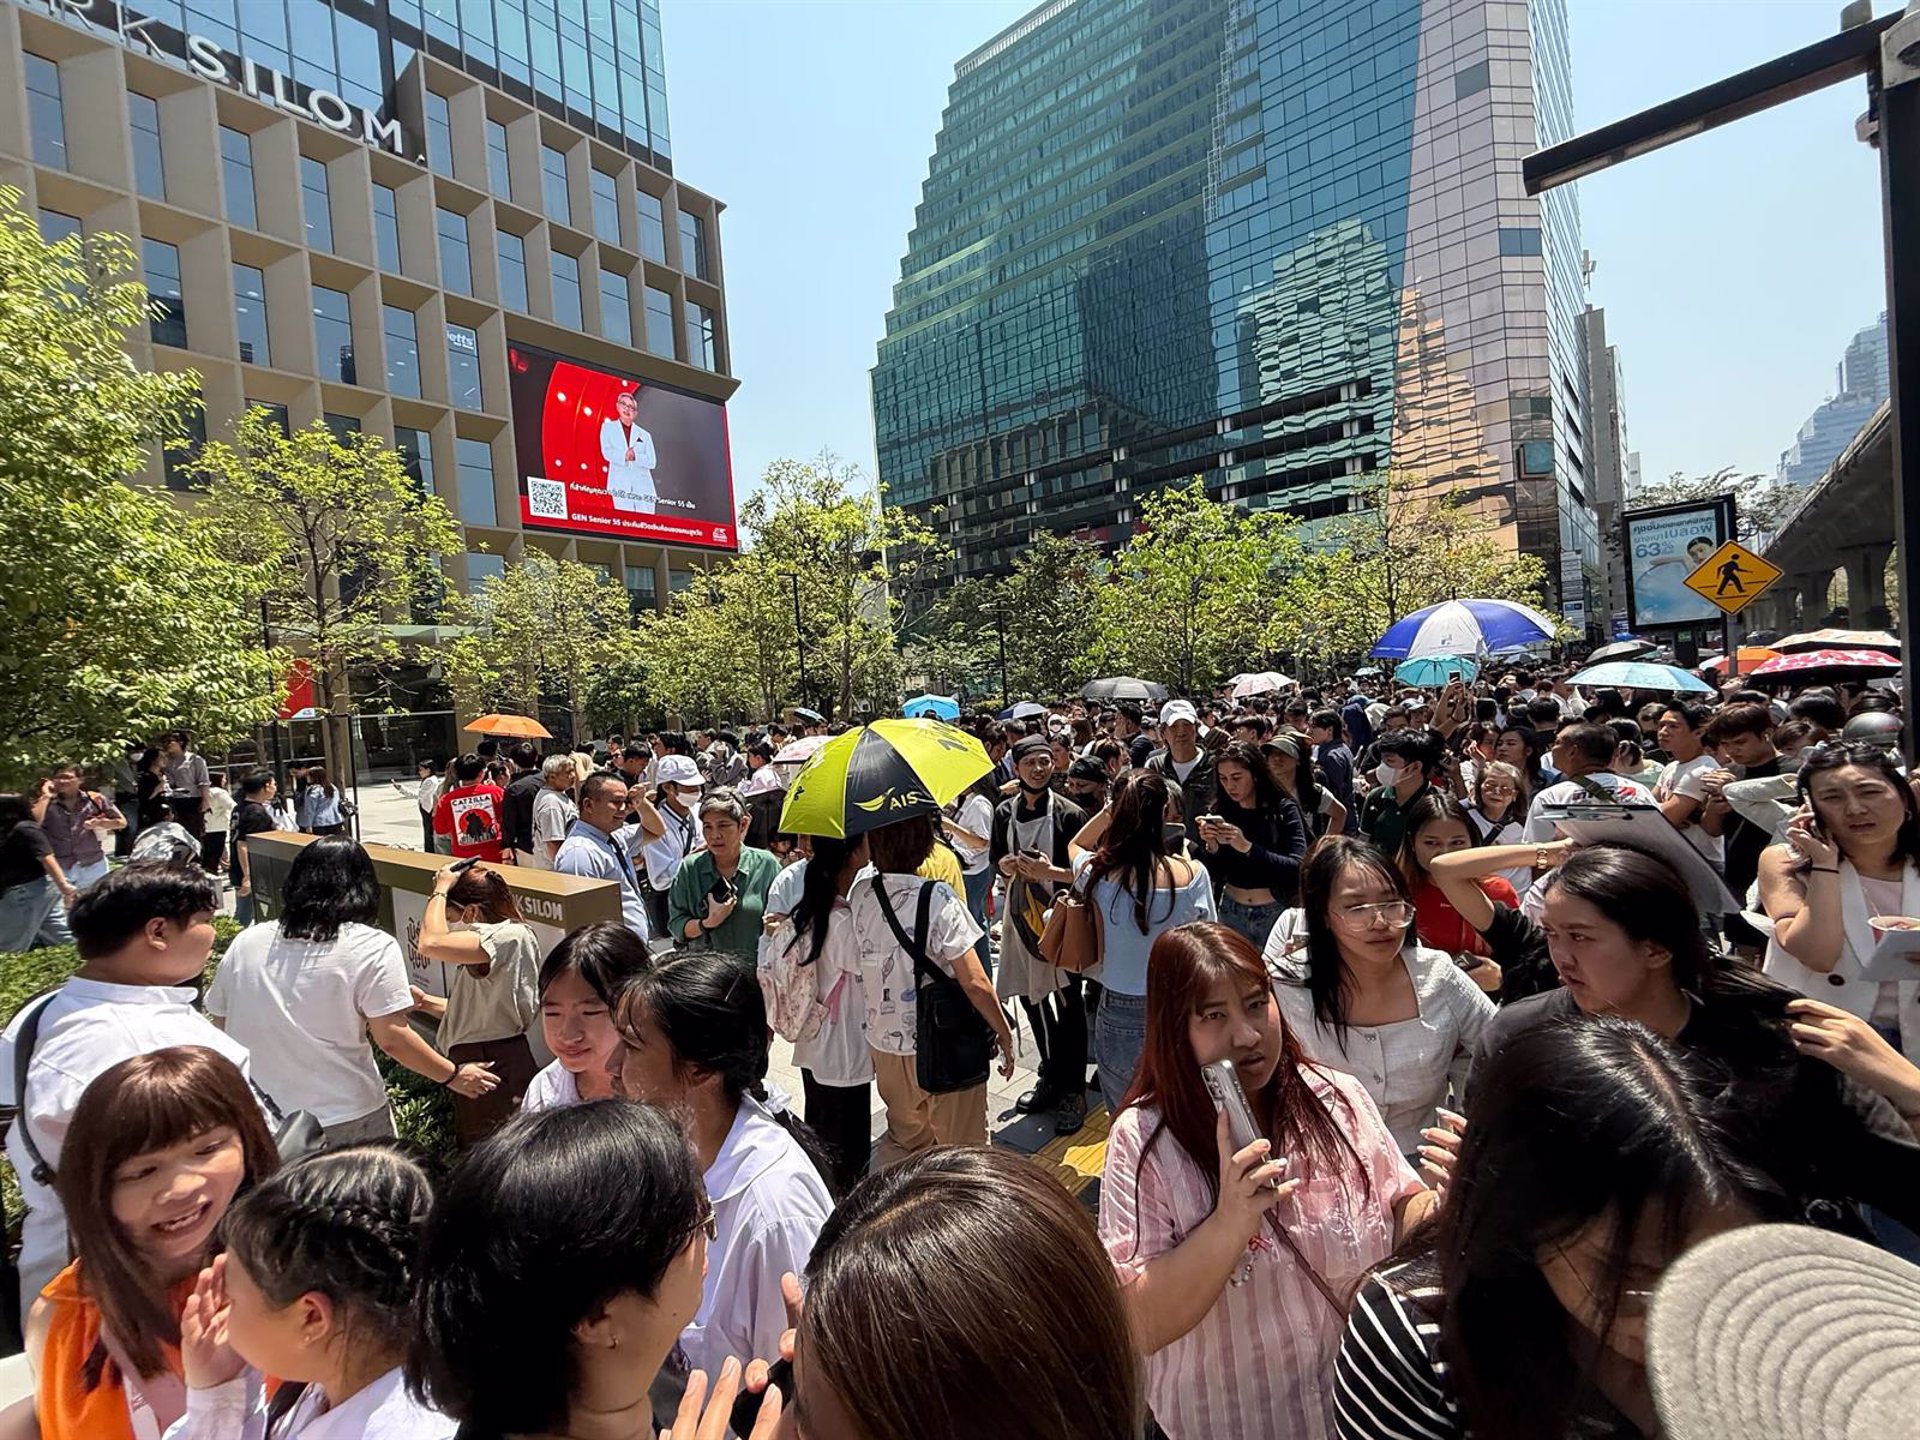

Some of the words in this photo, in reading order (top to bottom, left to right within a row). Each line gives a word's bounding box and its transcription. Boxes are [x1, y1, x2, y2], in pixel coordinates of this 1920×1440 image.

[187, 34, 402, 153] SILOM
[571, 513, 588, 522] GEN
[589, 515, 611, 526] Senior
[1635, 542, 1661, 558] 63
[452, 795, 490, 806] CATZILLA
[889, 791, 919, 811] AIS
[525, 896, 563, 921] SILOM
